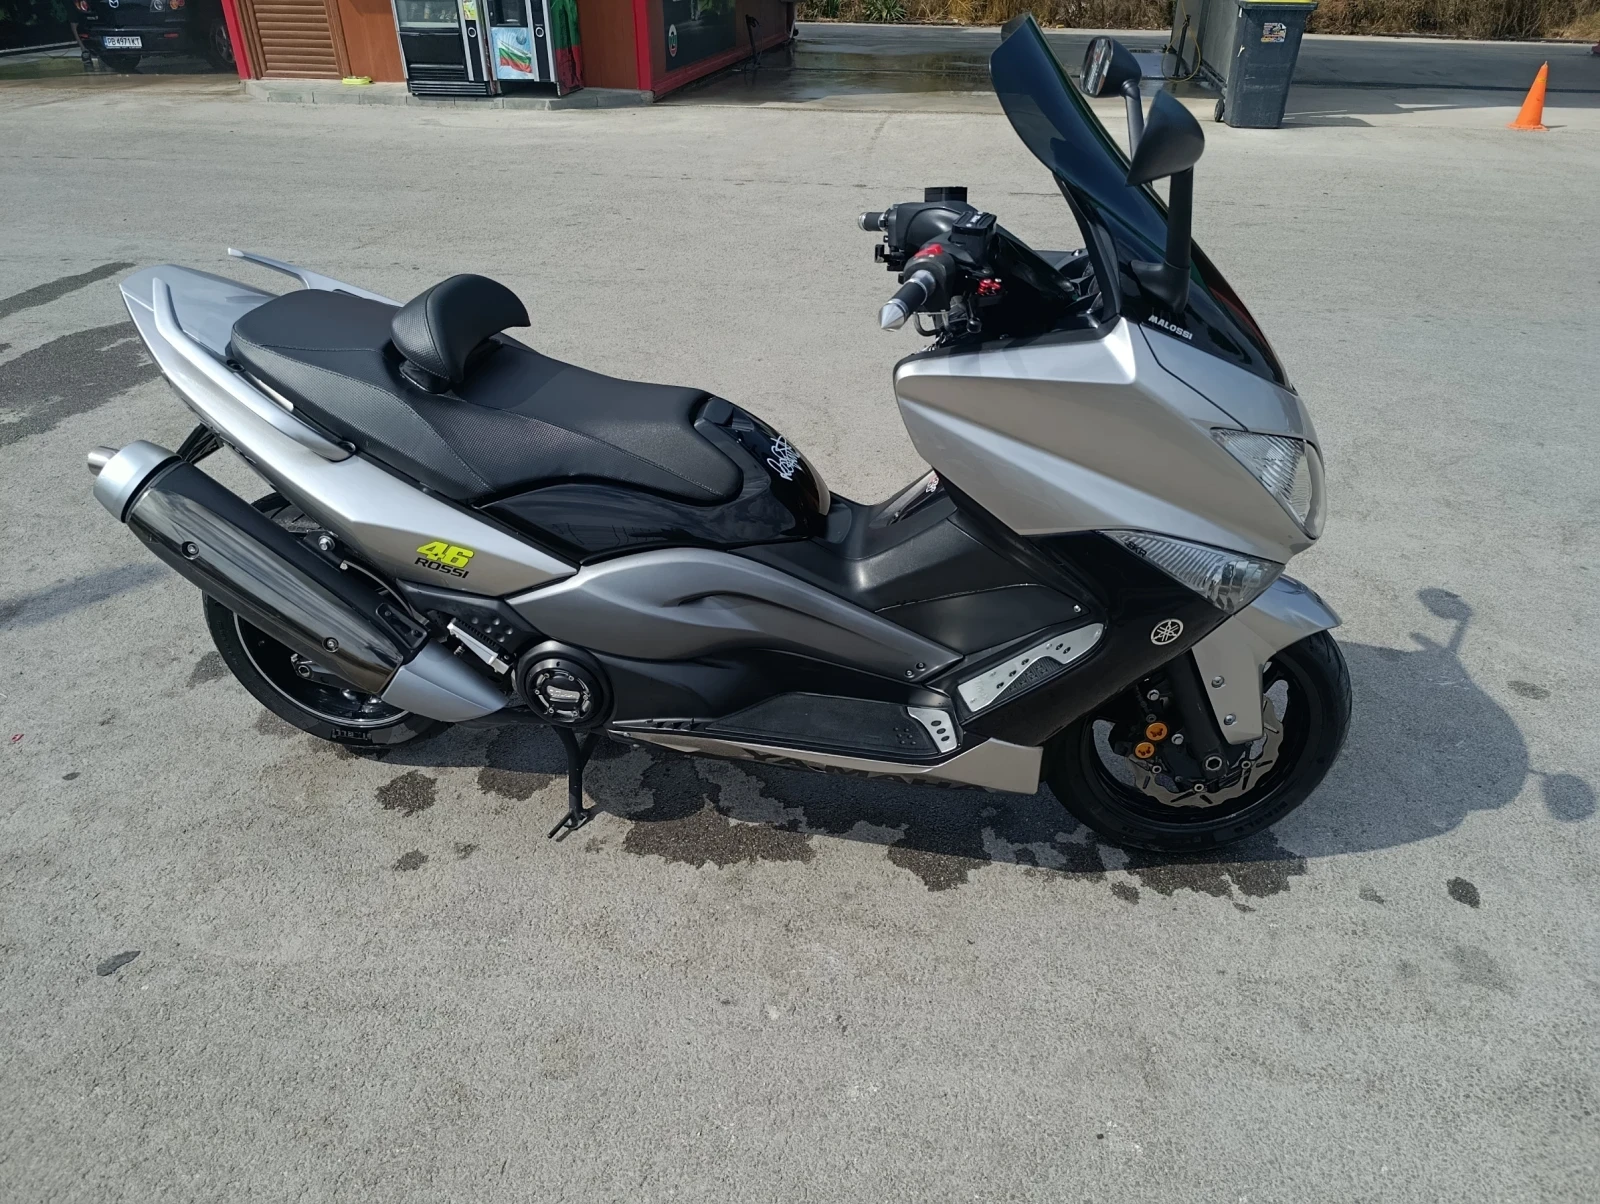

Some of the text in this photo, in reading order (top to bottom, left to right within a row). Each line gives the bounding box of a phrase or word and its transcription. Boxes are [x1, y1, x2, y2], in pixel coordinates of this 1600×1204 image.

[1148, 315, 1193, 340] MALOSSI
[417, 541, 475, 568] 46
[414, 557, 470, 579] ROSSI
